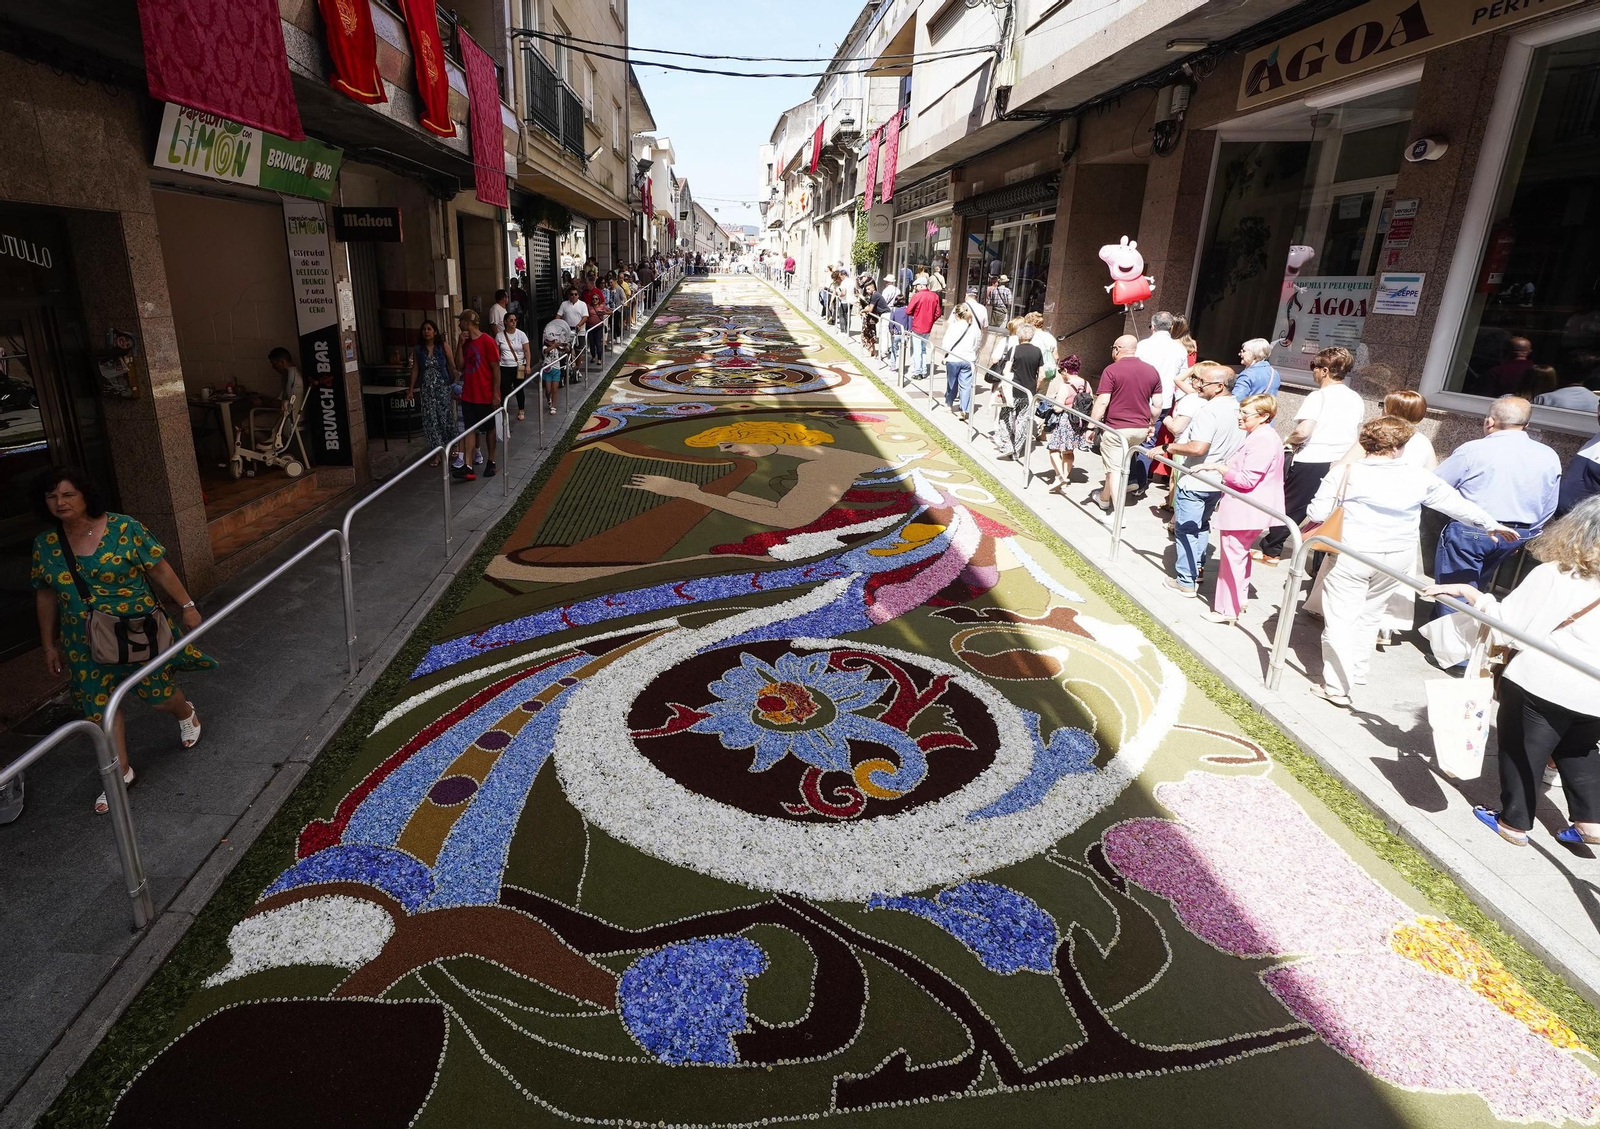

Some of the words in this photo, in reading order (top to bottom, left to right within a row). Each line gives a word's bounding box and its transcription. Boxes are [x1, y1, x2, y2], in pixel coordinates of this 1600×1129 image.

[266, 148, 309, 175] BRUNCH
[313, 162, 333, 181] BAR
[342, 213, 393, 227] Mahou
[1307, 291, 1366, 317] ÁGOA
[1397, 289, 1419, 298] CEPPE
[314, 340, 331, 373] BAR
[320, 388, 340, 450] BRUNCH
